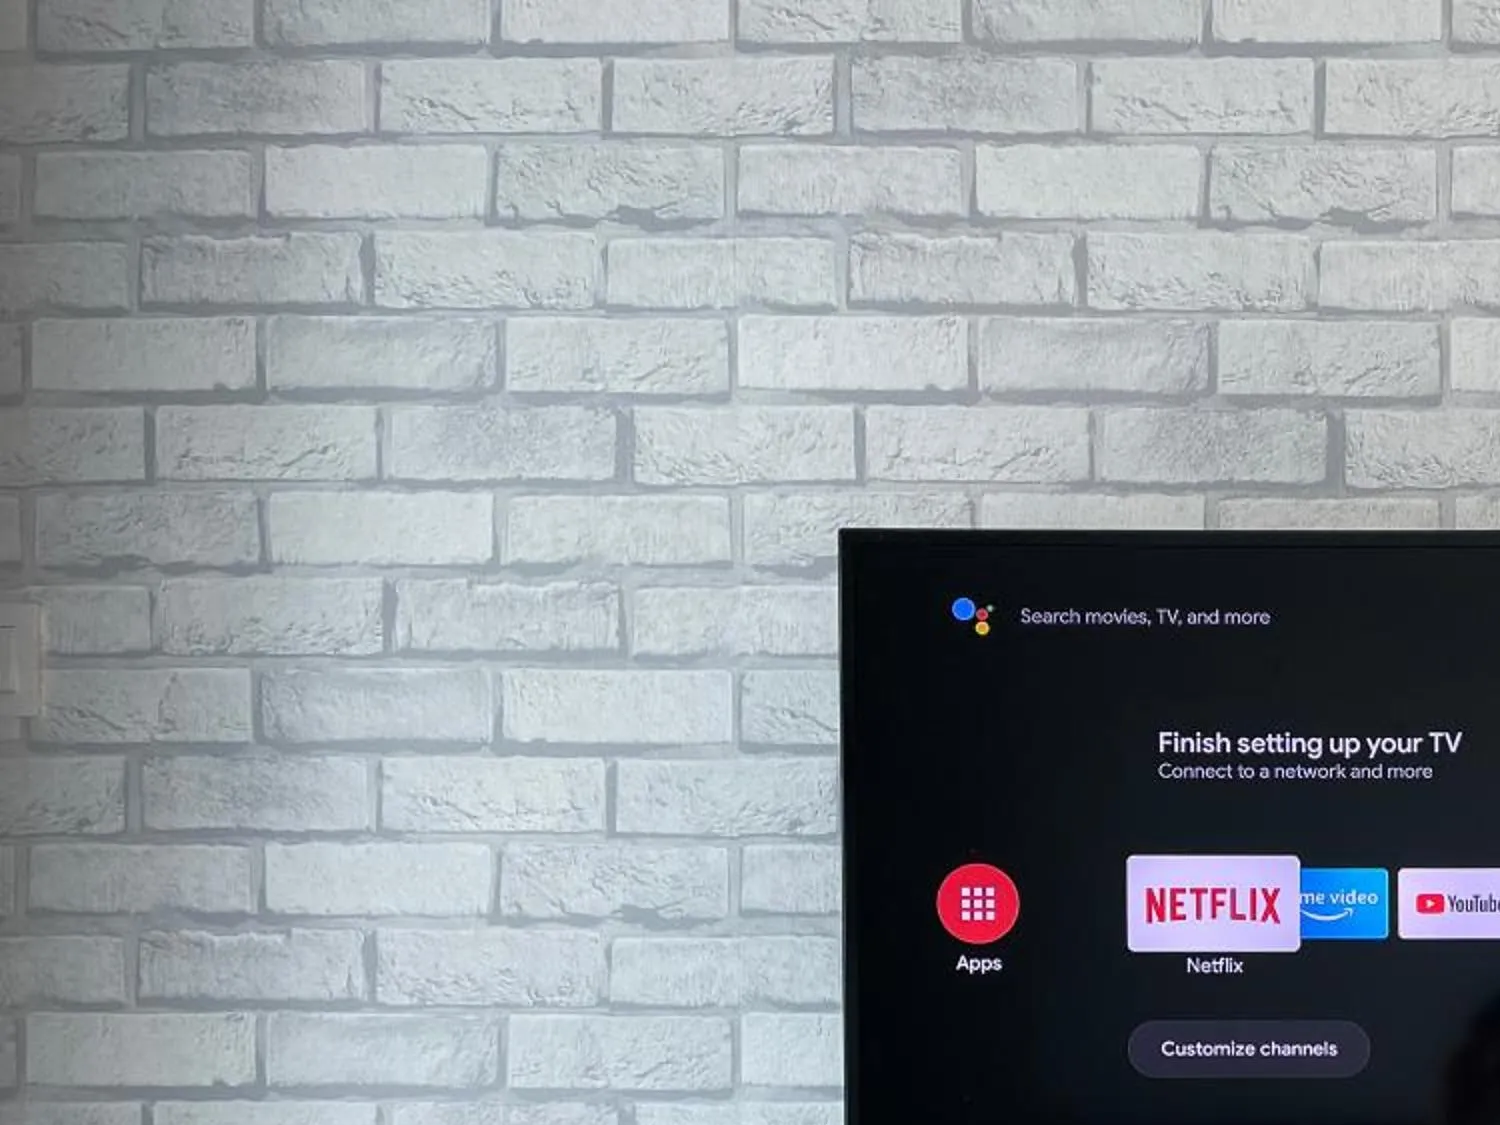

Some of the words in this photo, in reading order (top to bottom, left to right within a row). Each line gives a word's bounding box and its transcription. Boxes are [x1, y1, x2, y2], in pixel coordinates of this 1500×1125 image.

[1020, 607, 1081, 625] Search
[1085, 607, 1152, 627] movies,
[1156, 607, 1183, 626] TV,
[1187, 607, 1221, 625] and
[1224, 611, 1271, 625] more
[1158, 731, 1232, 755] Finish
[1236, 731, 1324, 761] setting
[1329, 737, 1362, 761] up
[1365, 737, 1424, 761] your
[1428, 731, 1463, 755] TV
[1158, 762, 1233, 780] Connect
[1236, 764, 1256, 780] to
[1258, 766, 1271, 780] a
[1274, 762, 1347, 780] network
[1350, 762, 1384, 780] and
[1387, 766, 1433, 780] more
[1145, 887, 1281, 924] NETFLIX
[1329, 888, 1380, 906] video
[955, 954, 1003, 975] Apps
[1186, 956, 1244, 974] Netflix
[1161, 1039, 1256, 1058] Customize
[1260, 1039, 1339, 1058] channels
